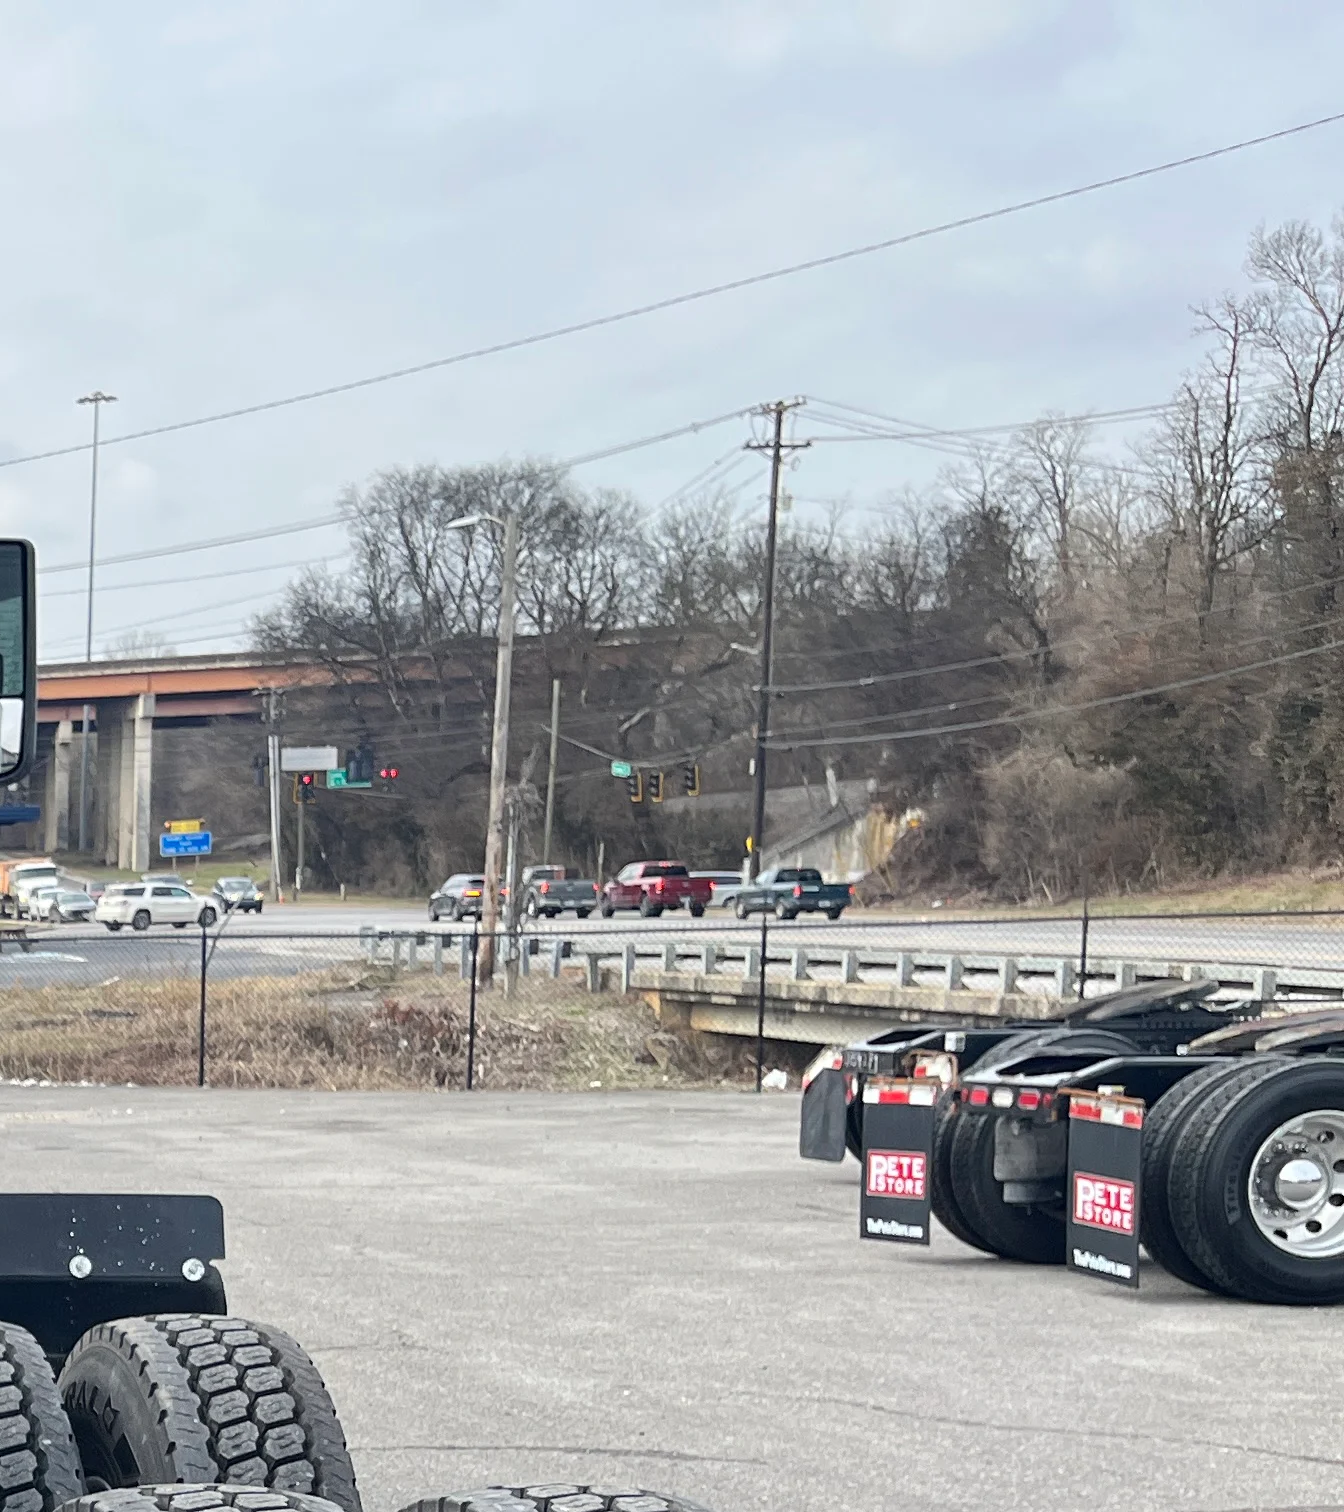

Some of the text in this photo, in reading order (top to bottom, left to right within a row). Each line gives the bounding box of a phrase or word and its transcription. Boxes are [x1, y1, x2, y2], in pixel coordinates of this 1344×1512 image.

[869, 1154, 924, 1192] PETE
[876, 1175, 924, 1196] STORE
[1076, 1178, 1132, 1219] PETE
[1083, 1202, 1132, 1230] STORE
